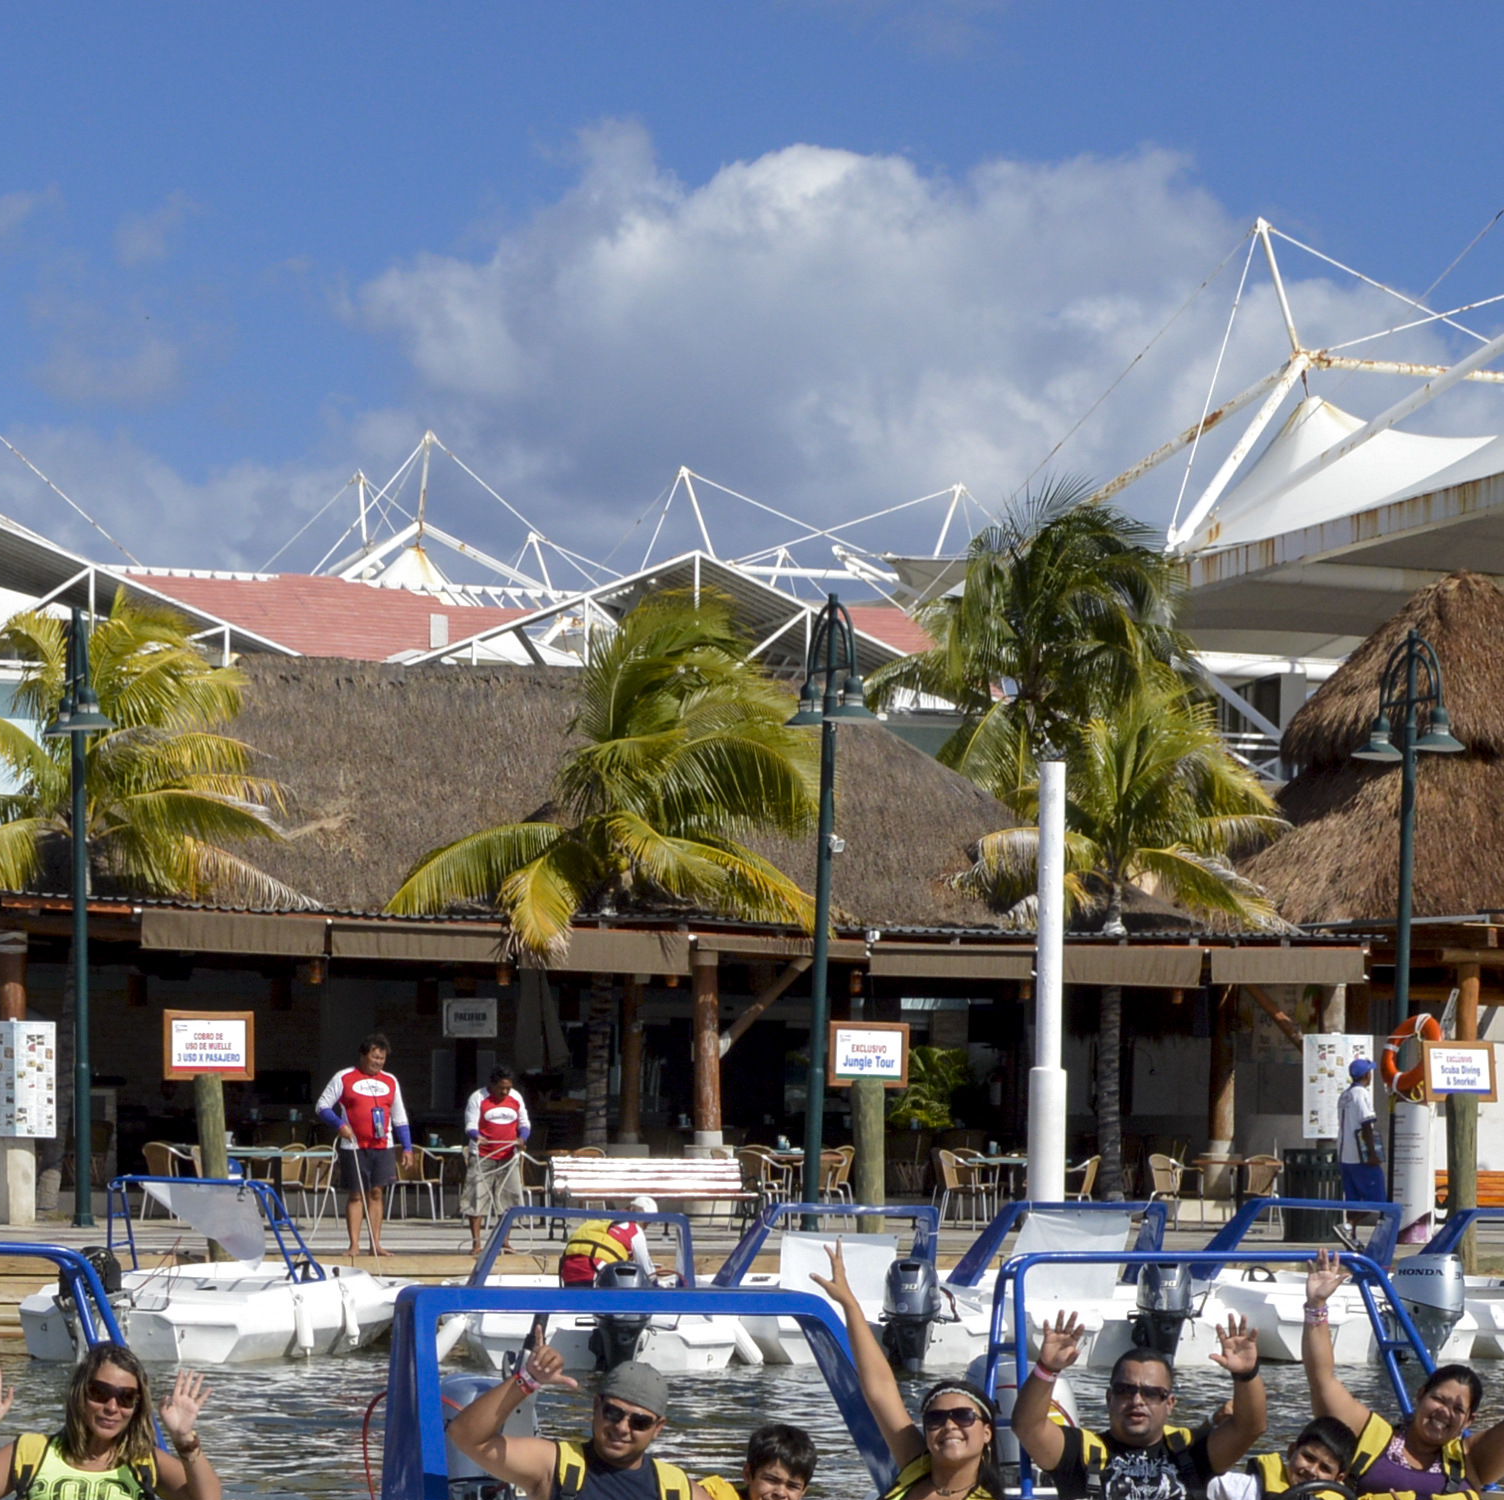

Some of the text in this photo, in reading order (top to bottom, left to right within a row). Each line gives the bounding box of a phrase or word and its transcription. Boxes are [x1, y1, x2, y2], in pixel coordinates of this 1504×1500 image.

[193, 1032, 224, 1040] COBRO DE
[184, 1042, 232, 1051] USO DE MUELLE
[851, 1043, 888, 1054] EXCLUSIVO
[177, 1053, 241, 1062] 3 USD X PASAJERO
[1446, 1055, 1473, 1063] EXCLUSIVO
[843, 1054, 895, 1071] Jungle Tour
[1440, 1064, 1481, 1077] Scuba Diving
[1446, 1076, 1477, 1086] & Snorkel
[1397, 1268, 1444, 1276] HONDA
